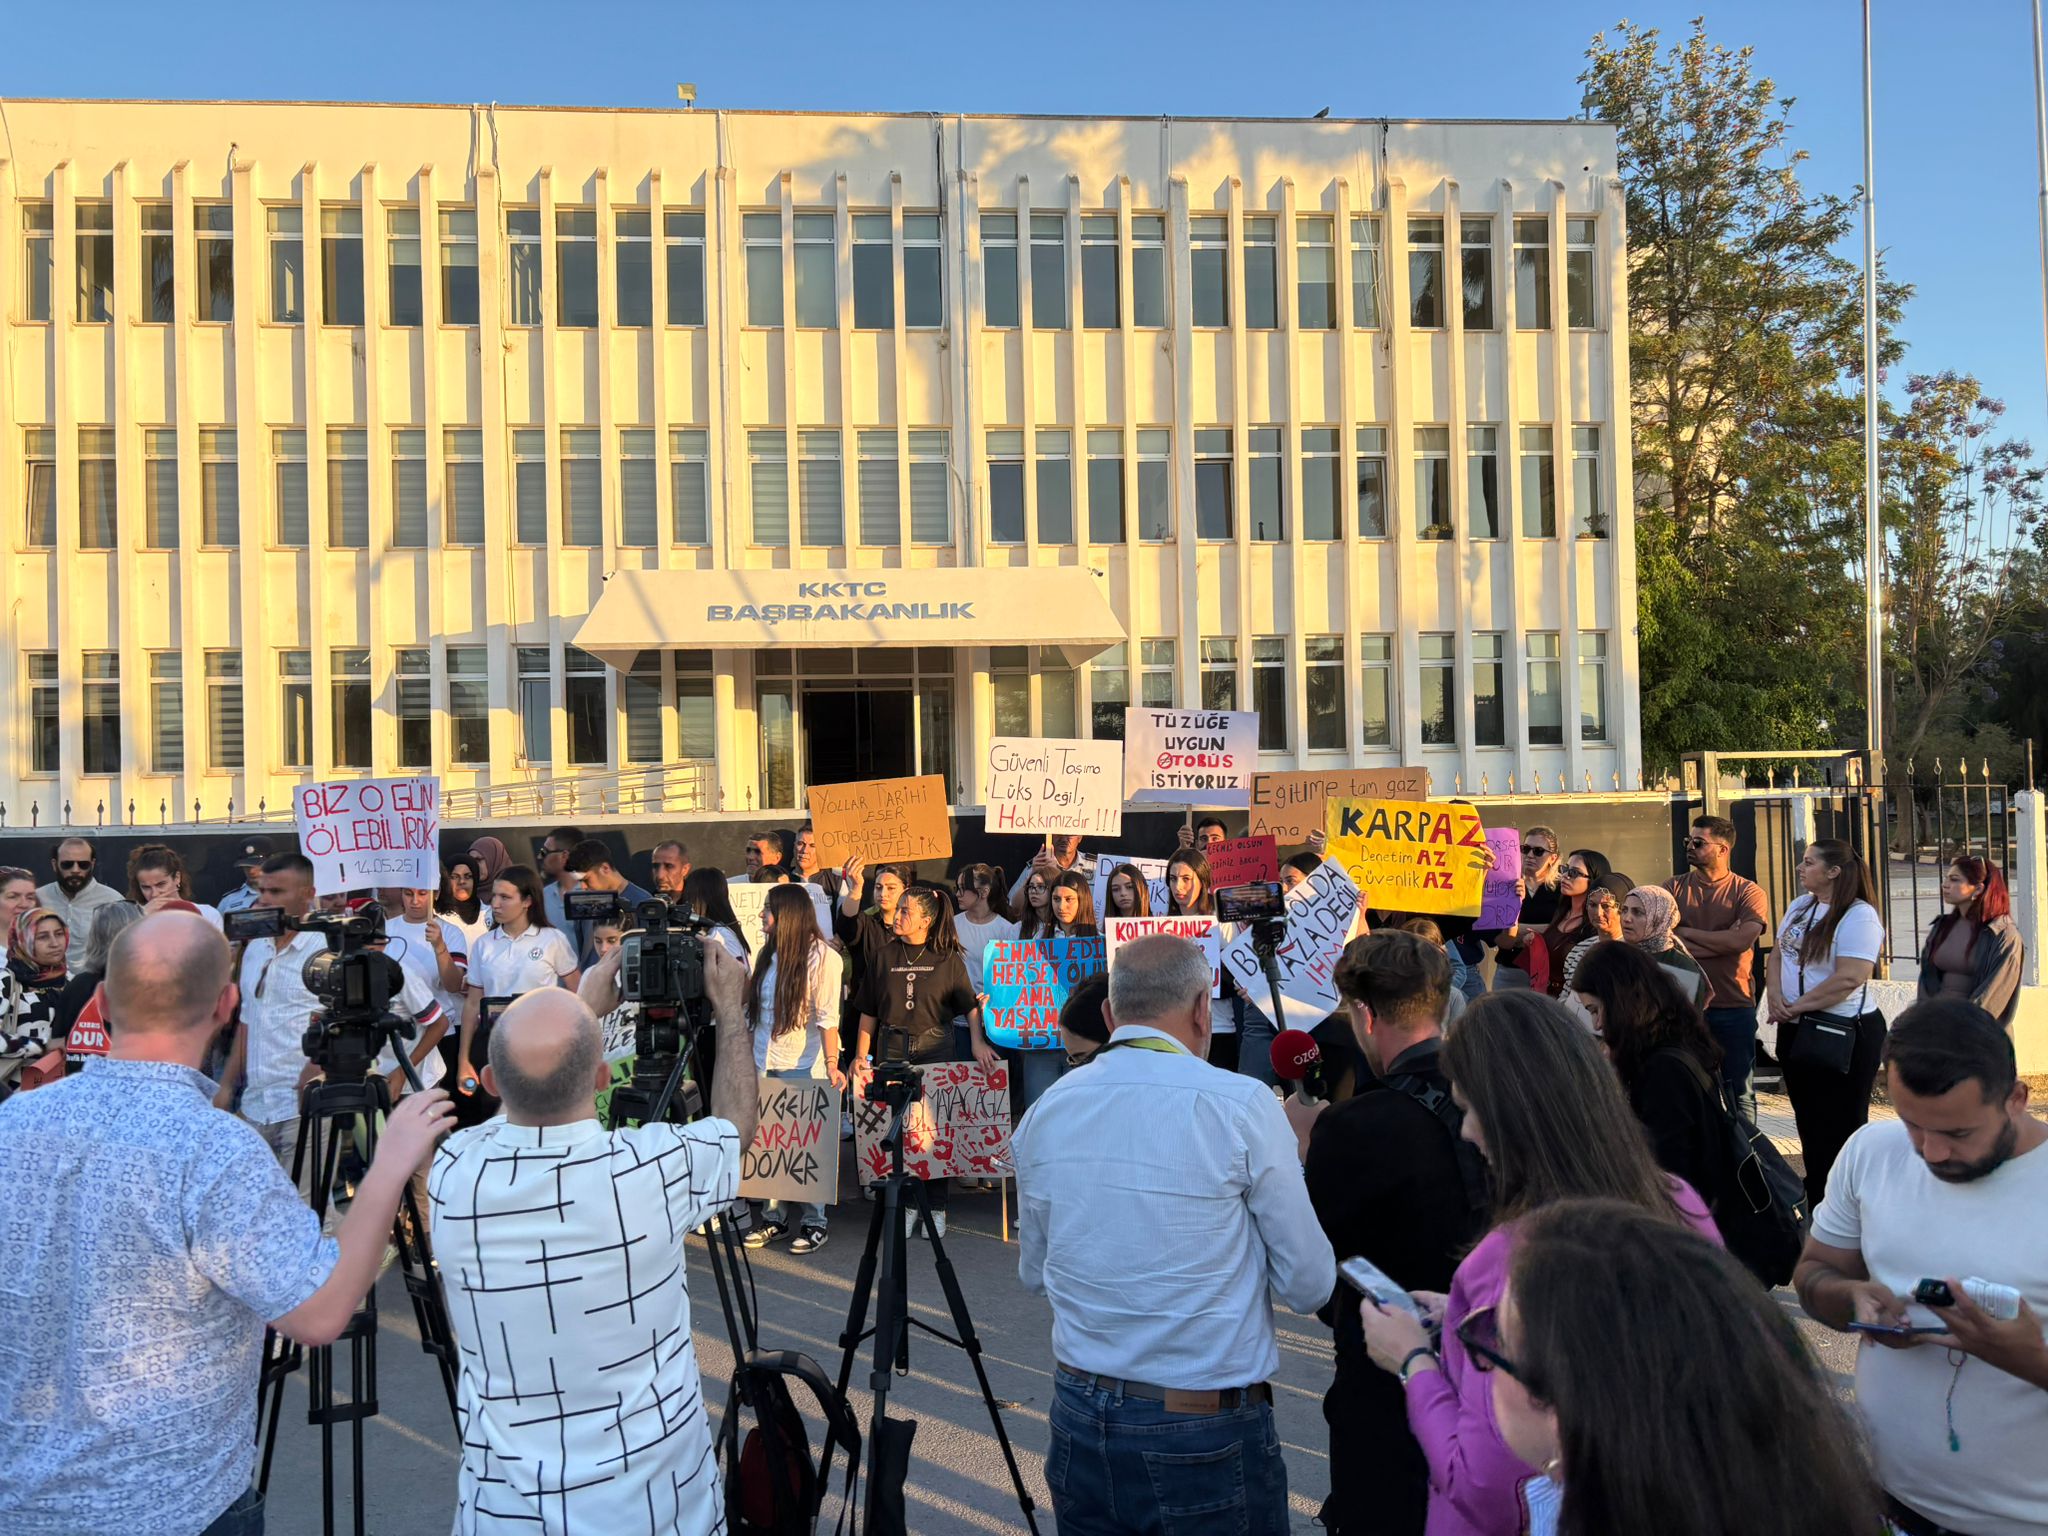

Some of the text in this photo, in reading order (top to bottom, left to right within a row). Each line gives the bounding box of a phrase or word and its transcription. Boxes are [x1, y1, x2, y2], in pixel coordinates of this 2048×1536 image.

[799, 582, 886, 598] KKTC
[708, 602, 976, 625] BAŞBAKANLIK
[1151, 713, 1229, 730] TÜZÜĞE
[1165, 737, 1225, 751] UYGUN
[990, 745, 1050, 773] Güvenli
[992, 774, 1032, 800] Lüks
[1151, 770, 1238, 789] İSTİYORUZ
[1350, 778, 1378, 797] tam
[1386, 779, 1419, 799] gaz
[303, 779, 432, 818] BİZ O GÜN
[816, 783, 927, 814] YOLLAR TARİHİ
[863, 806, 906, 823] ESER
[999, 804, 1090, 829] Hakkımızdır
[822, 823, 912, 847] OTOBÜSLER
[1253, 818, 1299, 836] Ama
[1340, 807, 1486, 847] KARPAZ
[855, 836, 941, 860] MÜZELİK
[1361, 845, 1446, 867] Denetim AZ
[1347, 865, 1453, 889] Güvenlik AZ
[1015, 987, 1054, 1007] AMA
[72, 1030, 104, 1047] DUR
[772, 1085, 830, 1121] GELİR
[753, 1118, 822, 1150] EVRAN
